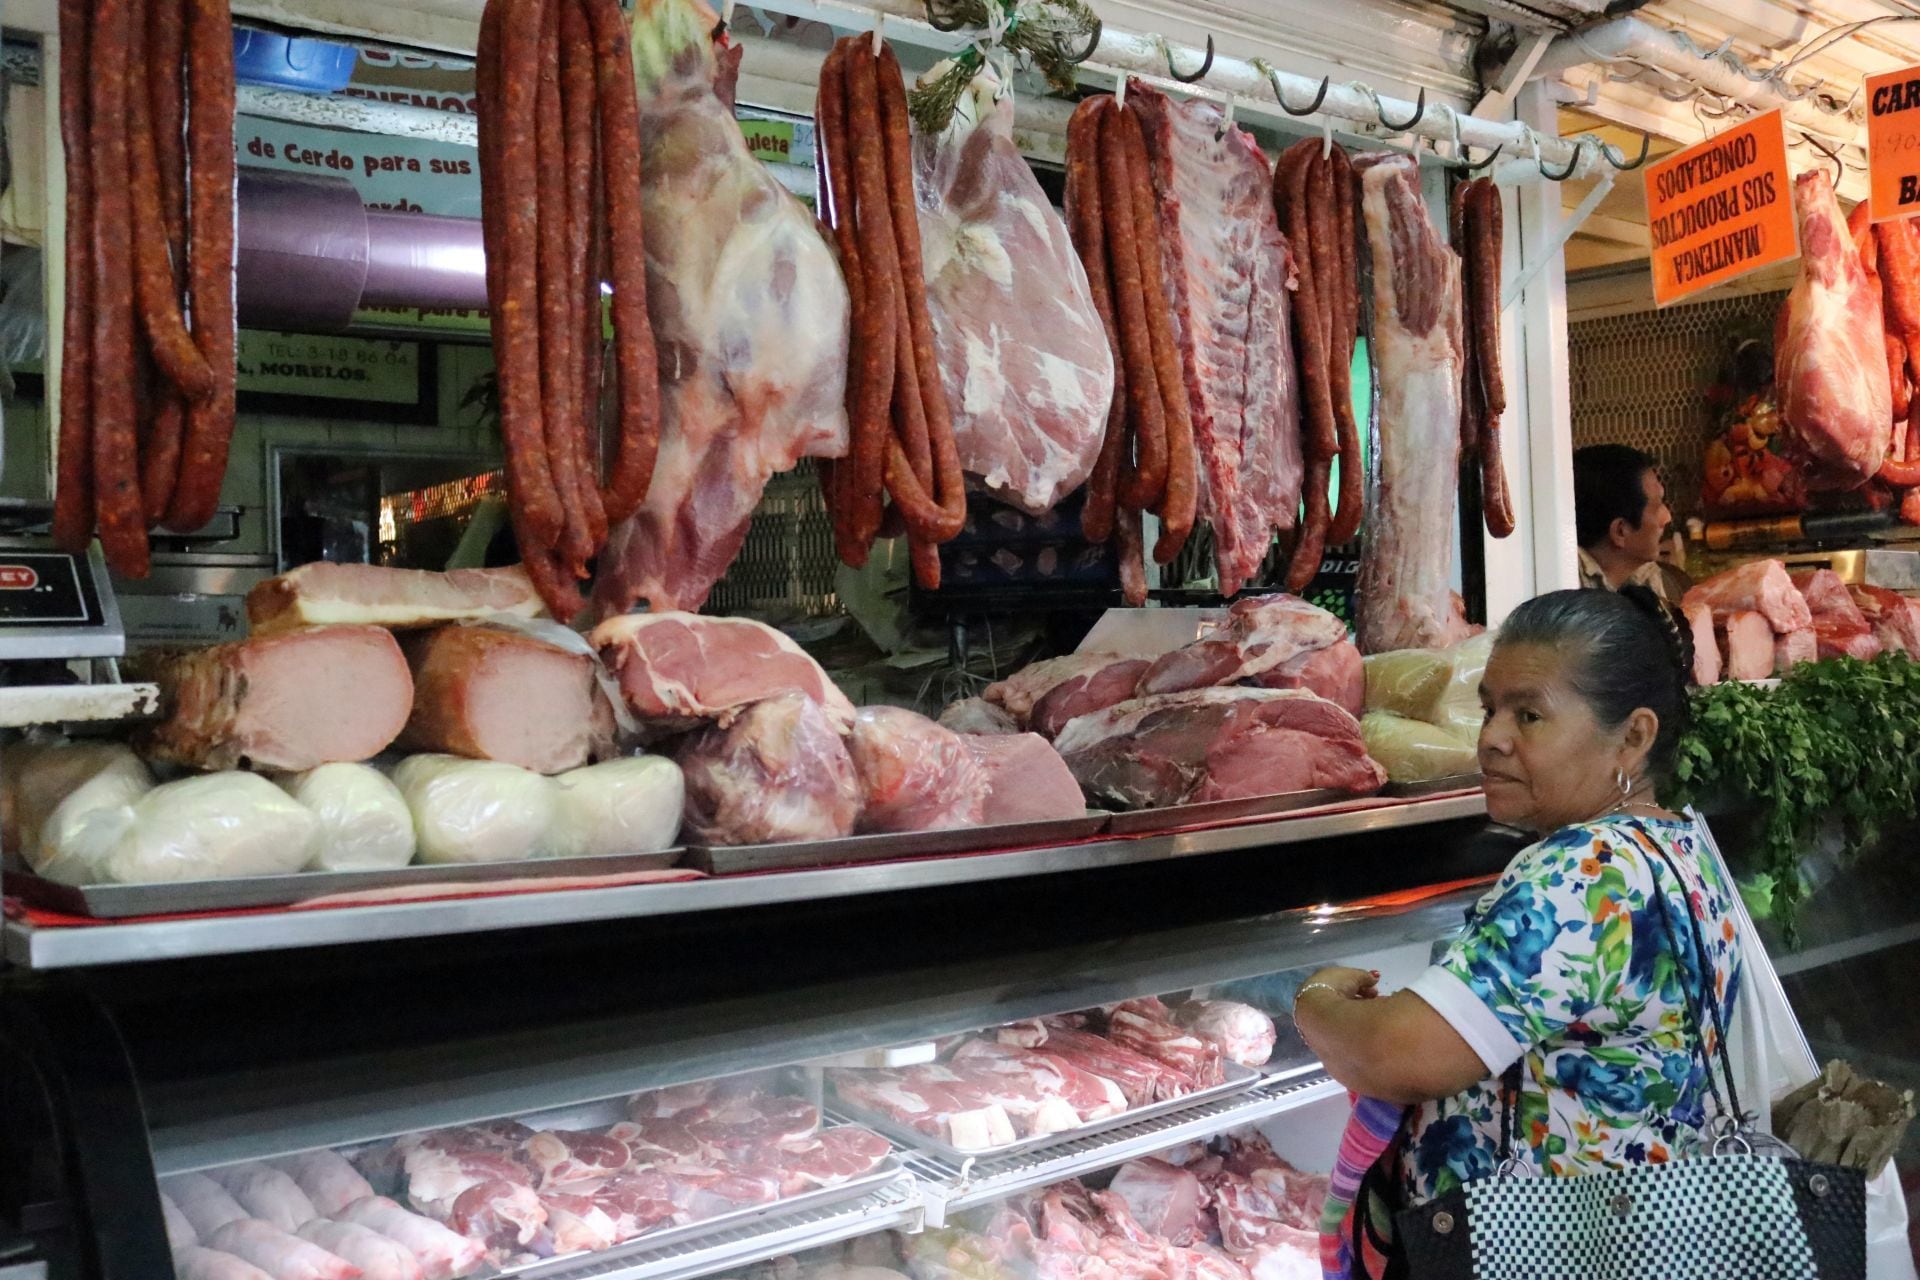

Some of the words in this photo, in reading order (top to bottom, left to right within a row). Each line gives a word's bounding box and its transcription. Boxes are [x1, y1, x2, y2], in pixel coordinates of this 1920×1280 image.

[248, 137, 276, 159] de
[284, 144, 354, 170] Cerdo
[363, 155, 421, 177] para
[429, 158, 472, 175] sus
[1657, 132, 1757, 203] CONGELADOS
[1743, 171, 1776, 212] SUS
[1899, 175, 1920, 206] B
[1652, 185, 1740, 249] PRODUCTOS
[1673, 224, 1761, 285] MANTENGA
